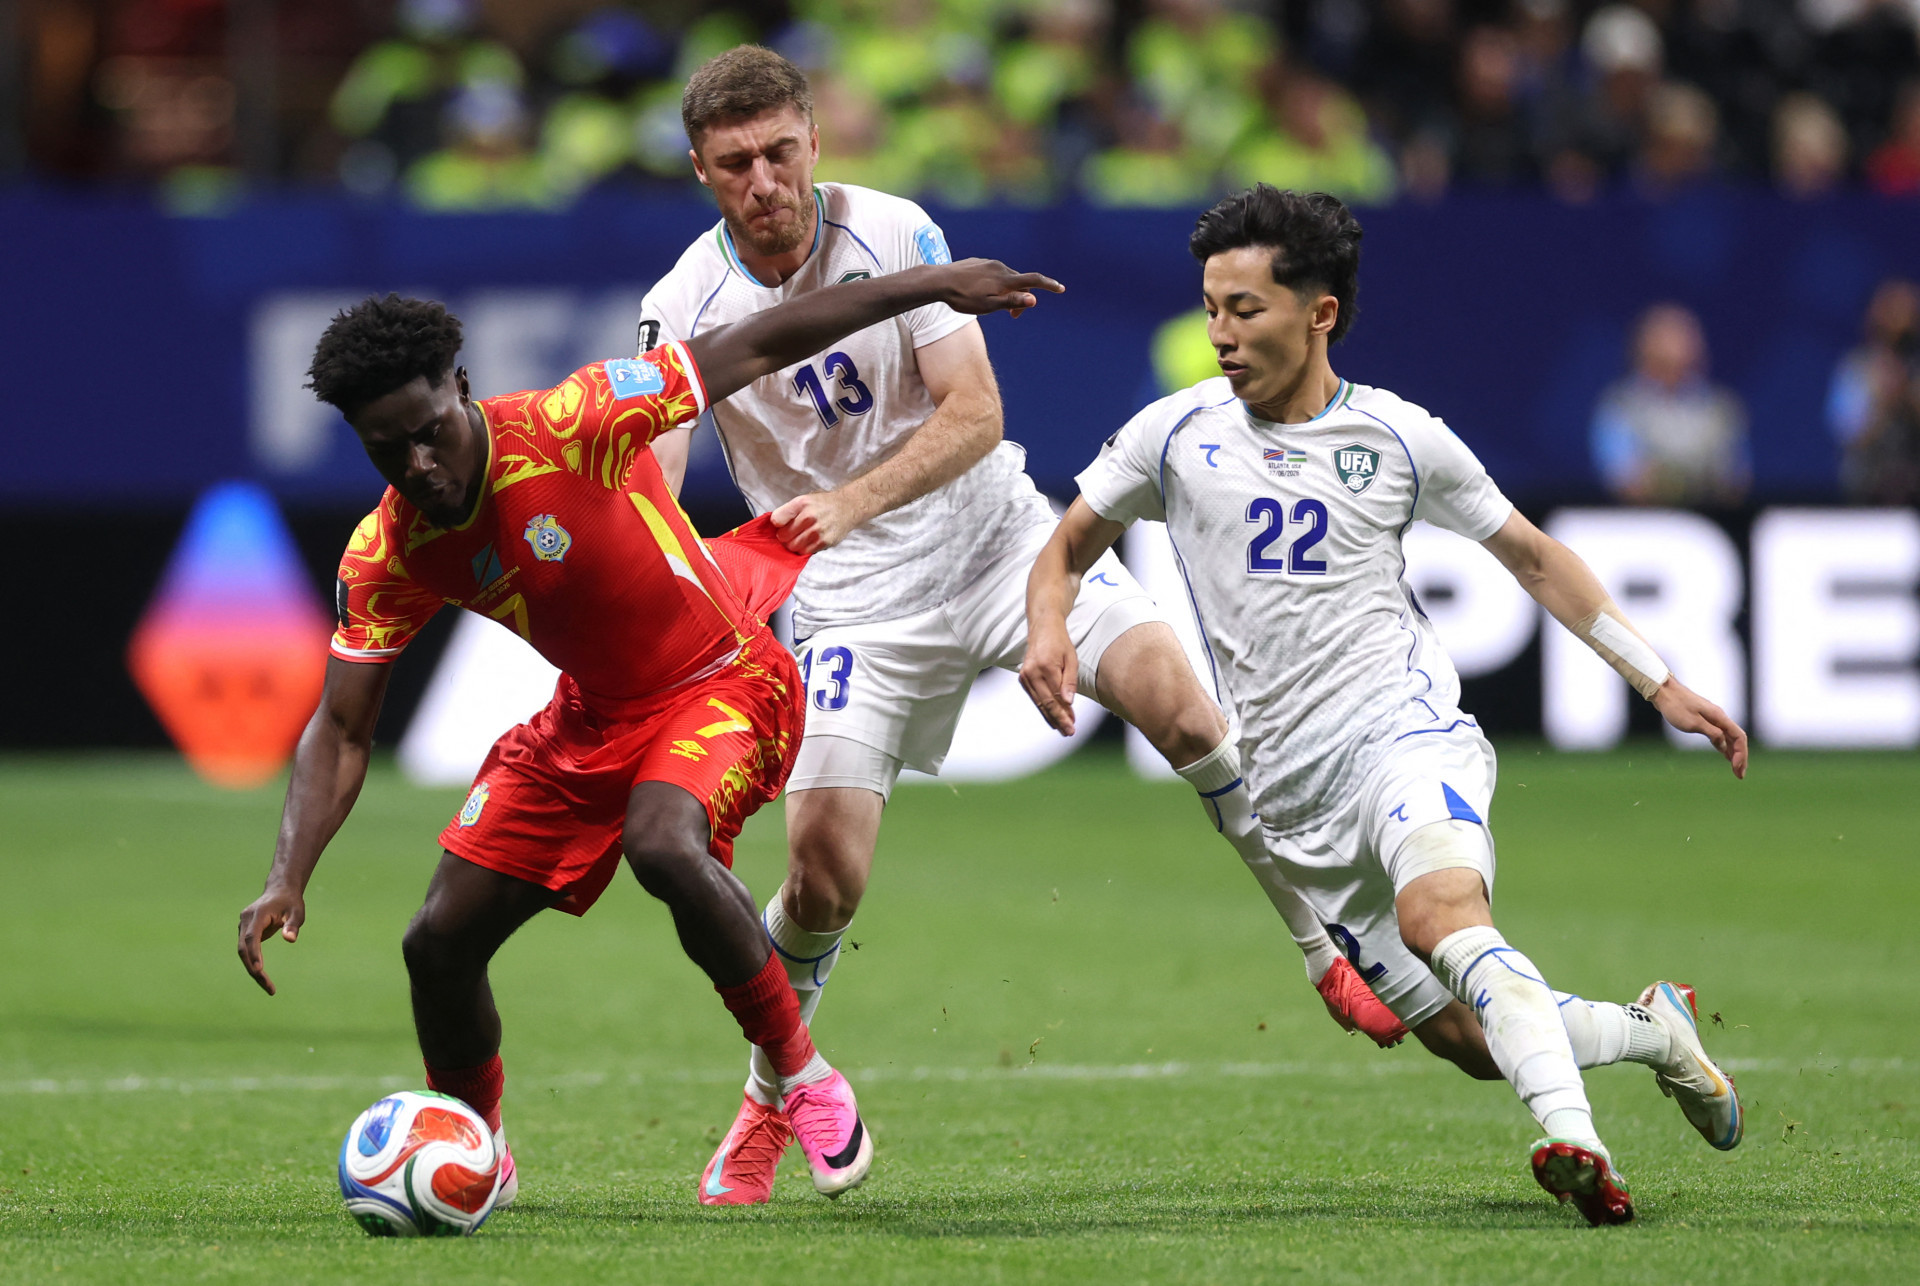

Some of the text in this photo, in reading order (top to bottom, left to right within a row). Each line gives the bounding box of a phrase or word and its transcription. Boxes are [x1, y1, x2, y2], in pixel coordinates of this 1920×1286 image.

[792, 352, 875, 430] 13
[1340, 453, 1373, 473] UFA
[544, 542, 566, 558] FECOFA
[1245, 497, 1328, 575] 22
[489, 592, 532, 643] 7
[694, 697, 752, 739] 7
[669, 748, 700, 762] umbro
